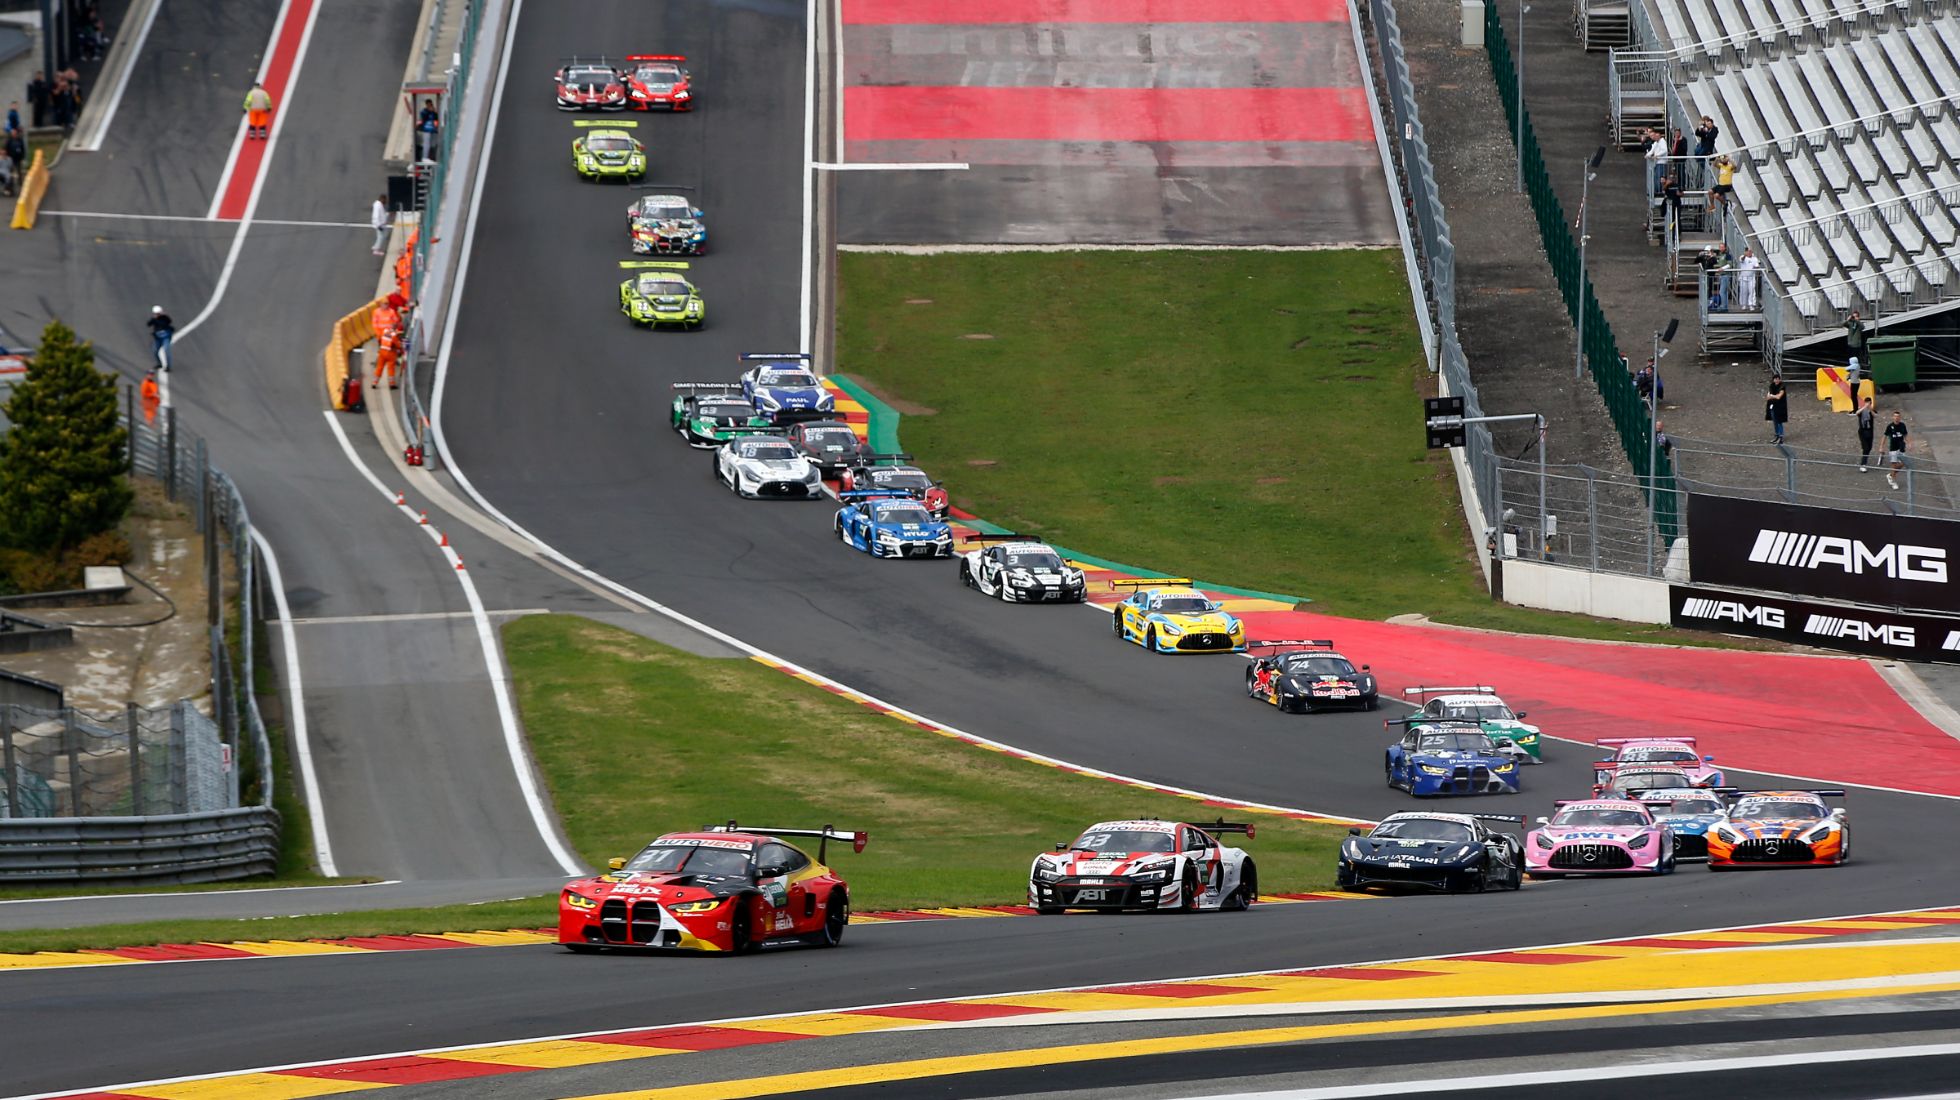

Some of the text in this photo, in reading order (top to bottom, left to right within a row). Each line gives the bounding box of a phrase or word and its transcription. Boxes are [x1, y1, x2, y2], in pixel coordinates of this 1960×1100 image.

[760, 375, 780, 384] 36
[700, 407, 718, 415] 63
[806, 432, 824, 442] 66
[742, 447, 757, 458] 18
[879, 511, 890, 522] 7
[1008, 555, 1019, 565] 3
[1806, 535, 1948, 583] AMG
[1151, 600, 1162, 610] 4
[1714, 601, 1785, 629] AMG
[1838, 619, 1916, 648] AMG
[1289, 660, 1310, 671] 74
[1449, 707, 1467, 718] 11
[1422, 736, 1446, 746] 25
[1733, 803, 1763, 818] 55
[1373, 822, 1407, 835] 37
[657, 839, 751, 850] AUTOHERO
[1079, 834, 1112, 849] 33
[1071, 888, 1111, 904] ABT
